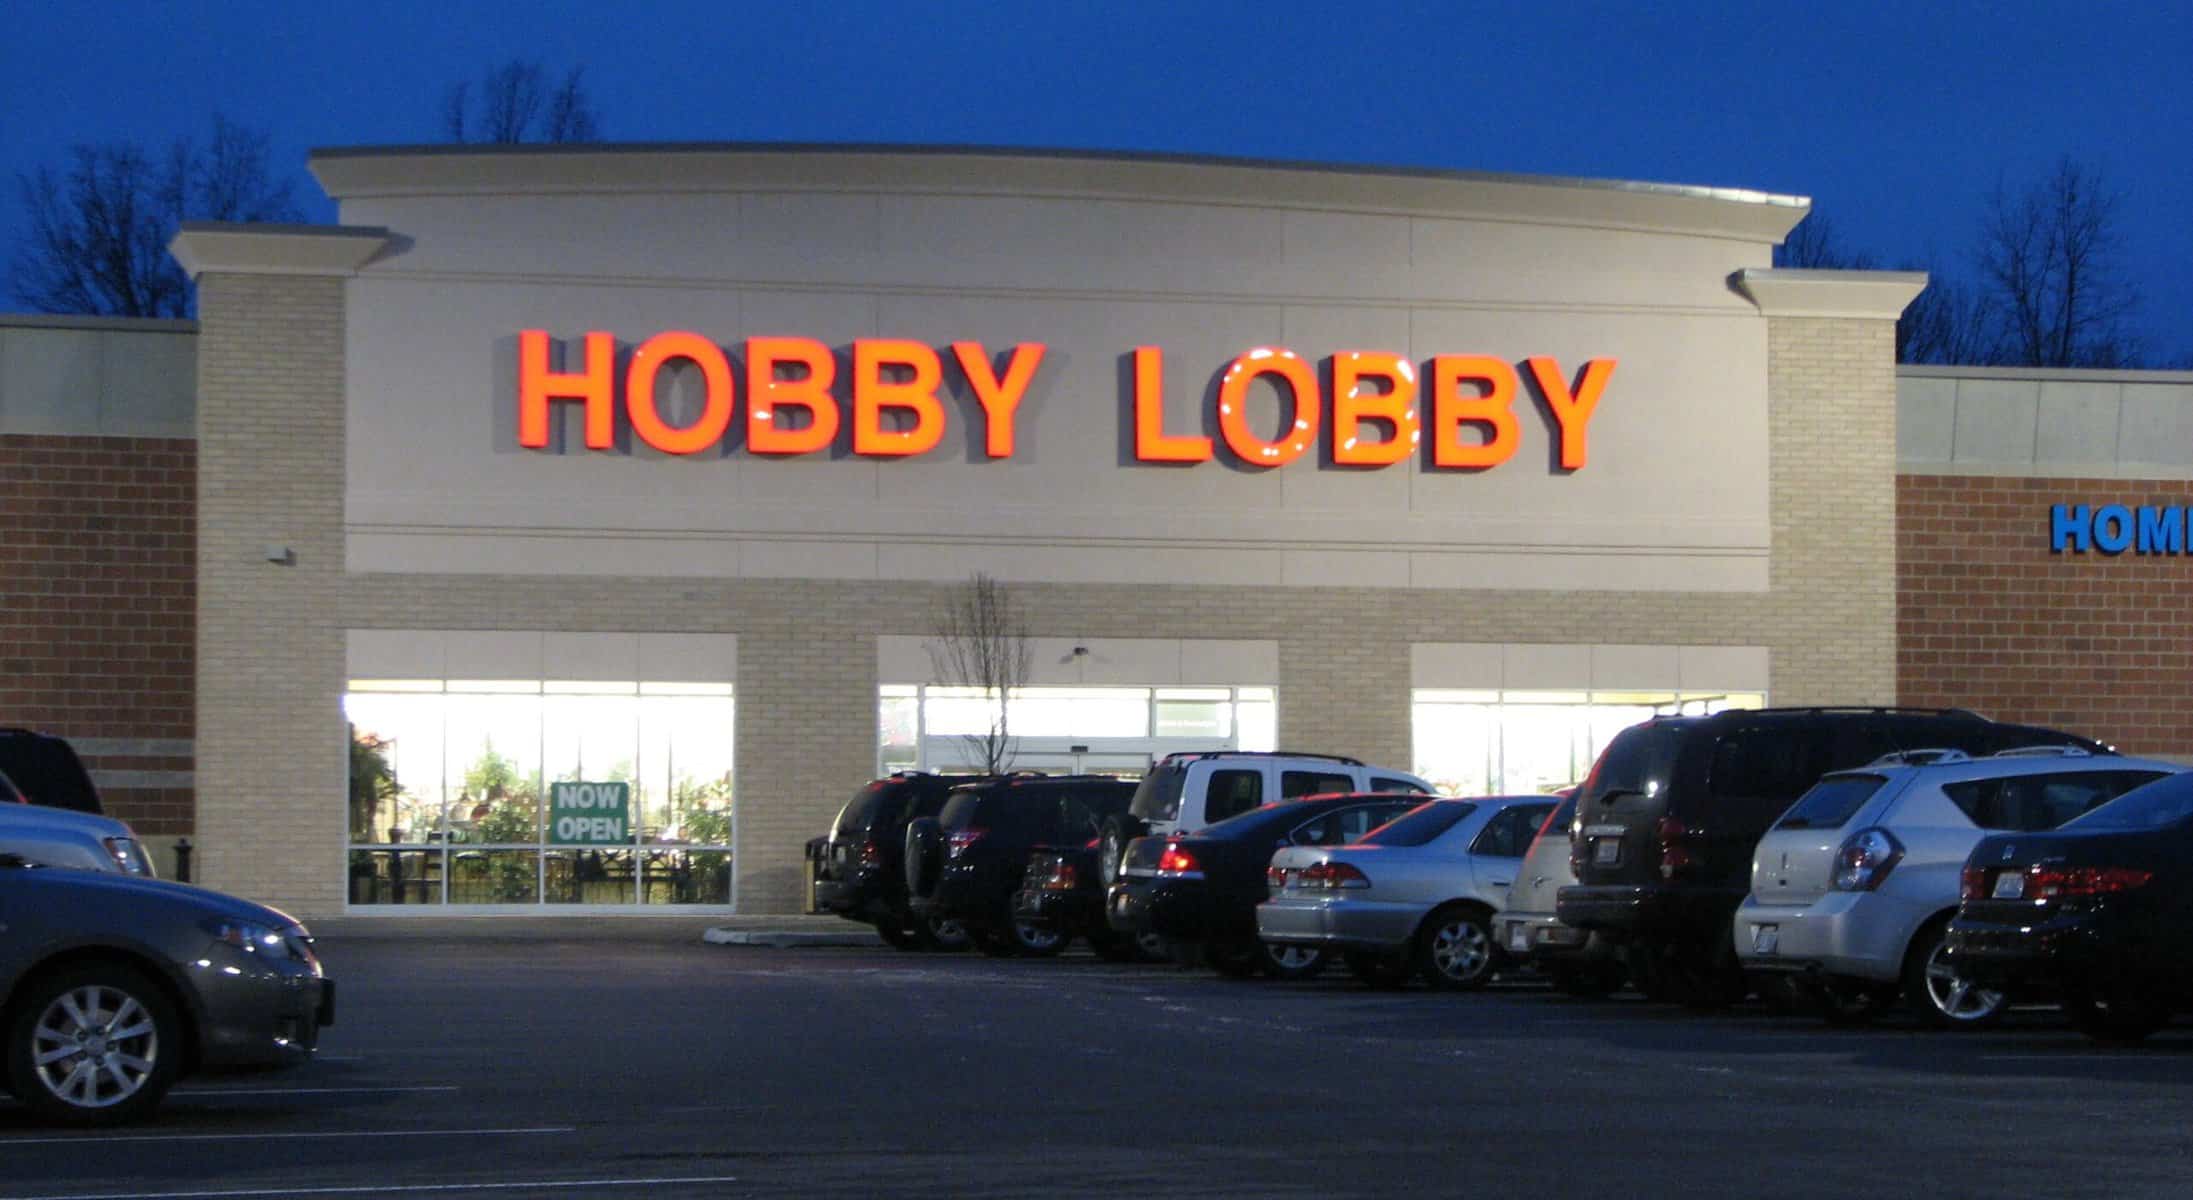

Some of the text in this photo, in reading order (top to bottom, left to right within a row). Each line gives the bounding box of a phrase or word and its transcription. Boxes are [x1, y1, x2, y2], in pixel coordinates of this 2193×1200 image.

[518, 329, 1618, 470] HOBBY LOBBY
[2051, 503, 2193, 555] HOM
[558, 784, 620, 809] NOW
[557, 816, 622, 840] OPEN
